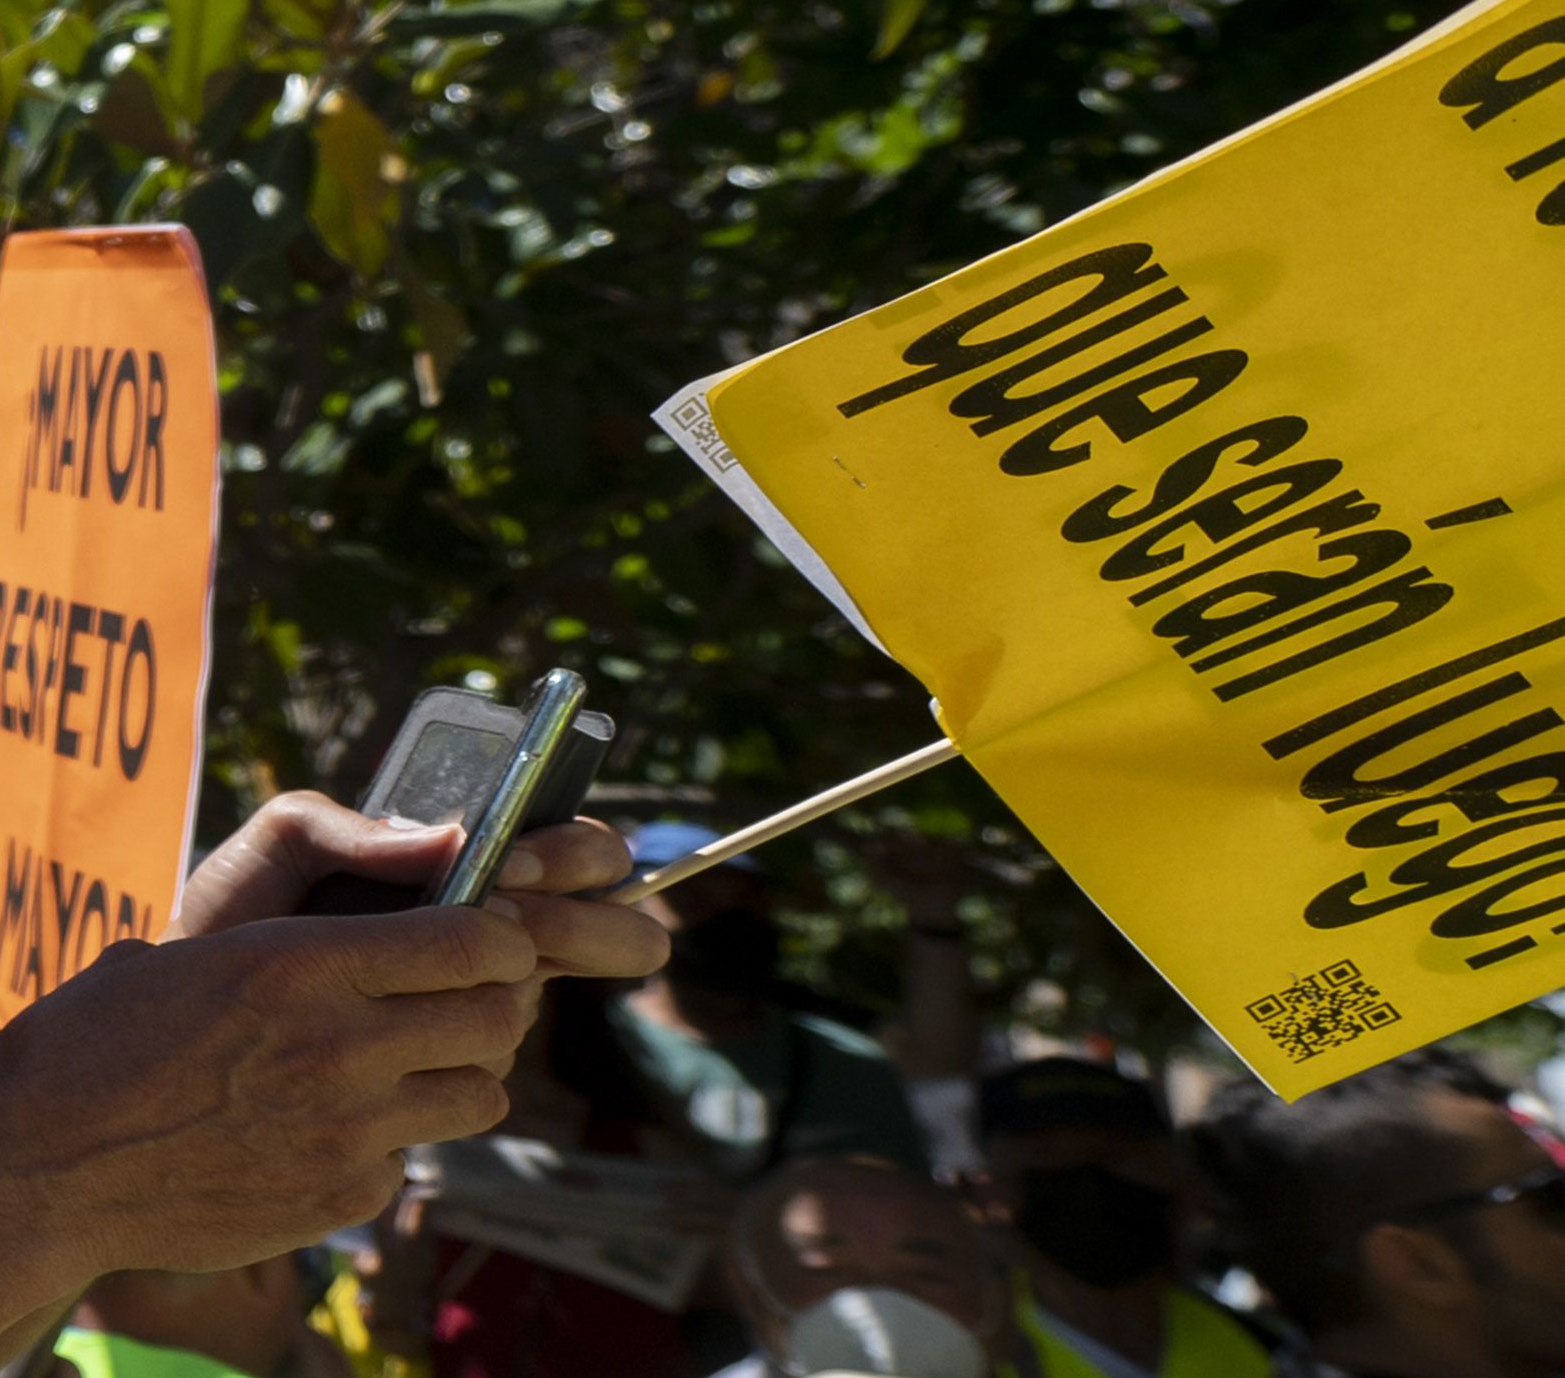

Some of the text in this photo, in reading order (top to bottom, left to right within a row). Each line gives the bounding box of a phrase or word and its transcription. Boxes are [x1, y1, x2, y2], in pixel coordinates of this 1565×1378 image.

[837, 242, 1249, 477] que
[1060, 415, 1513, 703] serán
[1260, 616, 1565, 970] luego
